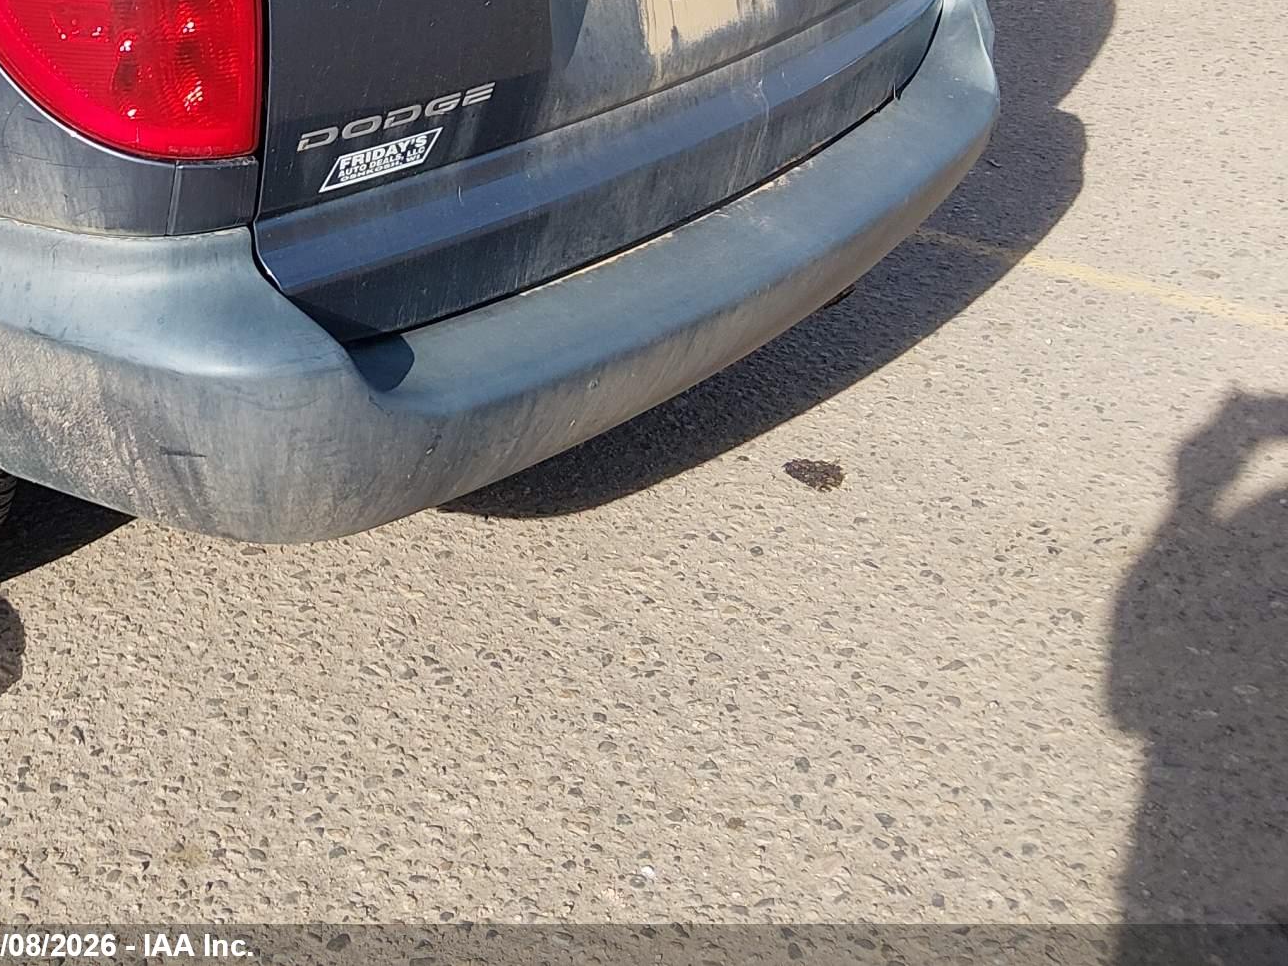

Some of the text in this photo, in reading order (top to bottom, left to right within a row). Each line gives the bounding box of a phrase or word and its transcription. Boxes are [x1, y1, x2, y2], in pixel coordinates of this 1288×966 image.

[296, 81, 496, 153] DODGE
[338, 163, 368, 179] AUTO
[406, 145, 426, 157] LLC
[339, 134, 428, 170] FRIDAY'S
